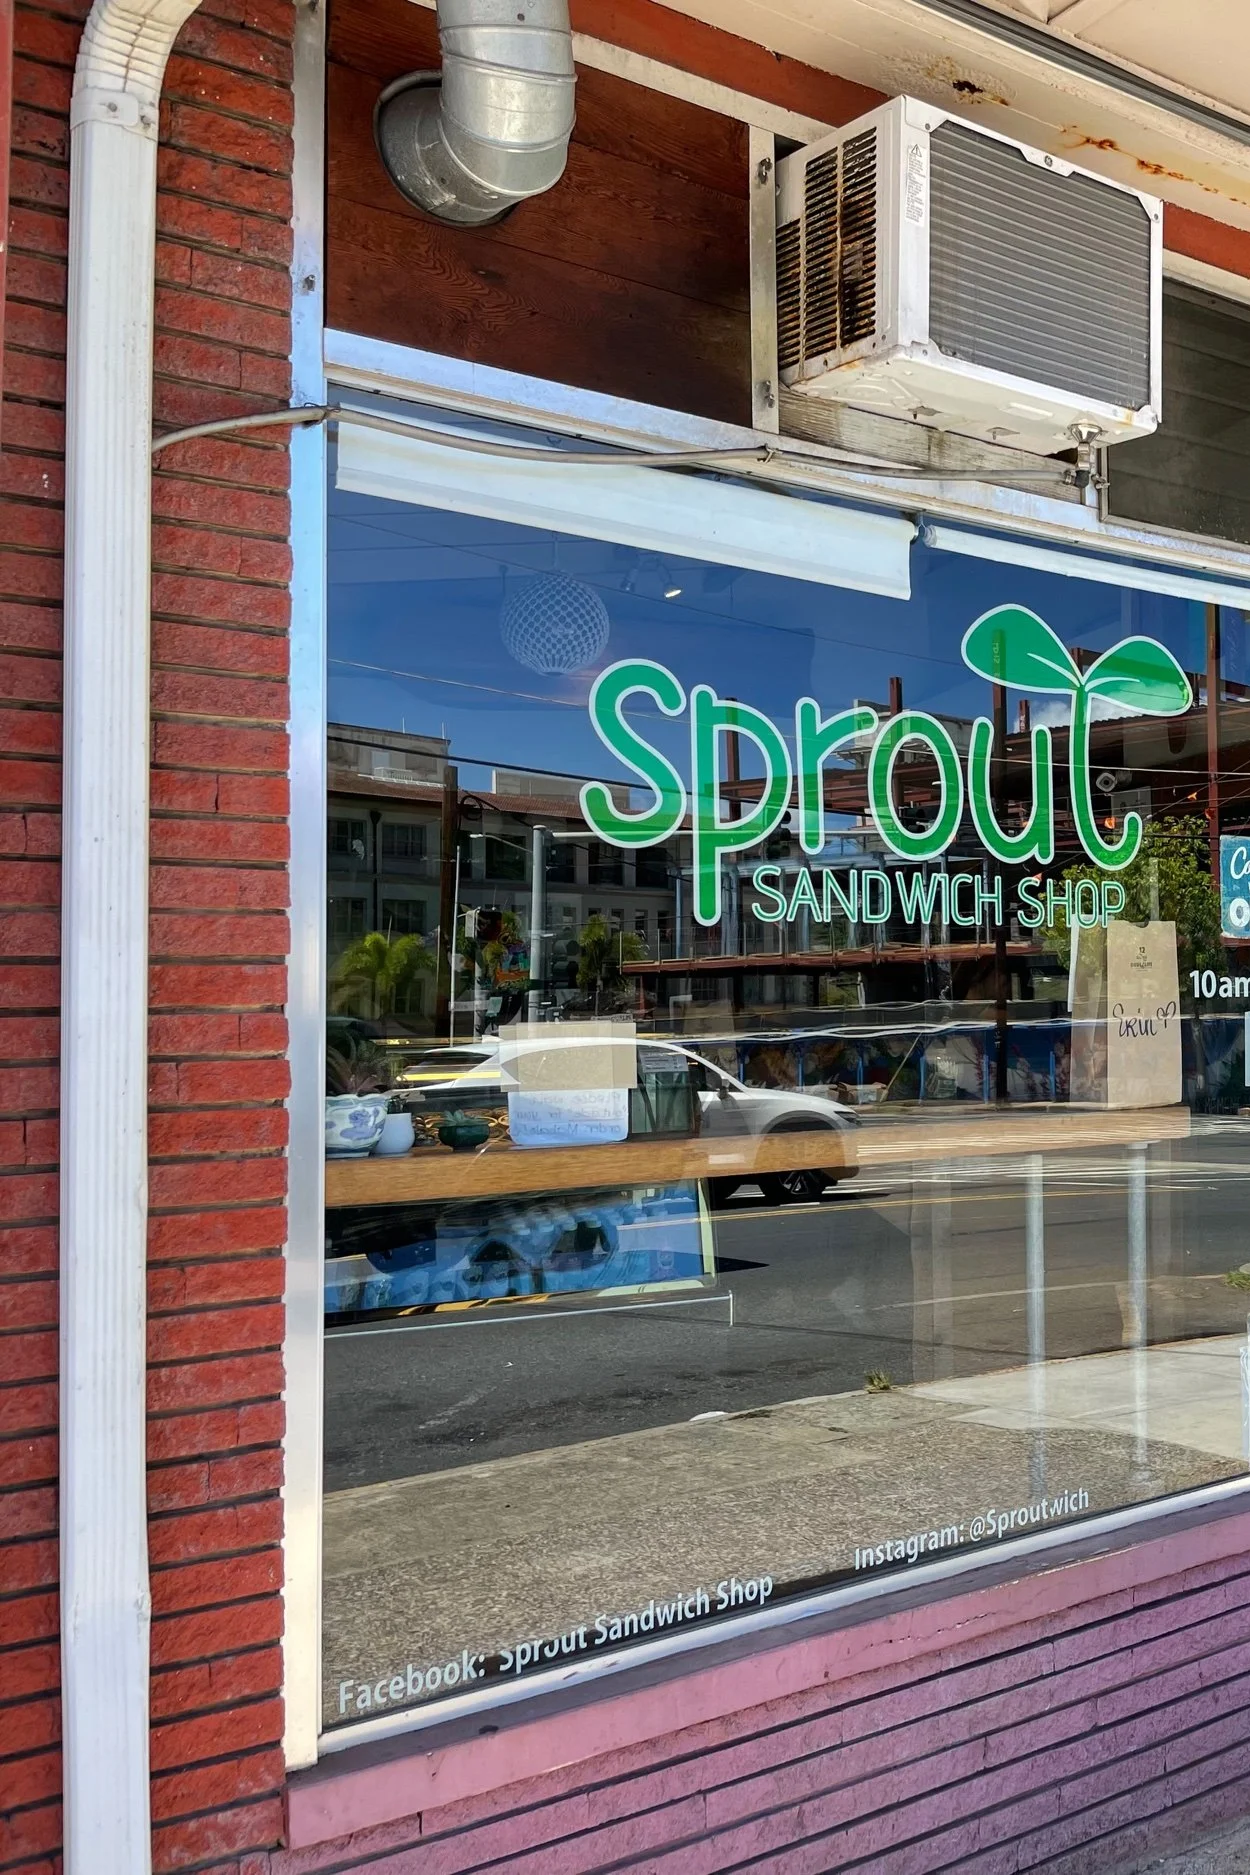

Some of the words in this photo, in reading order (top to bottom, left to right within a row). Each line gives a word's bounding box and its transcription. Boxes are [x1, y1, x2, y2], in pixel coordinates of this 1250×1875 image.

[579, 603, 1191, 926] Sprout
[752, 865, 1002, 926] SANDWICH
[1017, 875, 1125, 928] SHOP
[1138, 946, 1146, 954] 12
[855, 1523, 964, 1570] Instagram:
[970, 1487, 1089, 1541] @Sproutwich
[339, 1649, 486, 1714] Facebook:
[500, 1624, 587, 1675] Sprout
[594, 1587, 710, 1645] Sandwich
[716, 1575, 773, 1605] Shop
